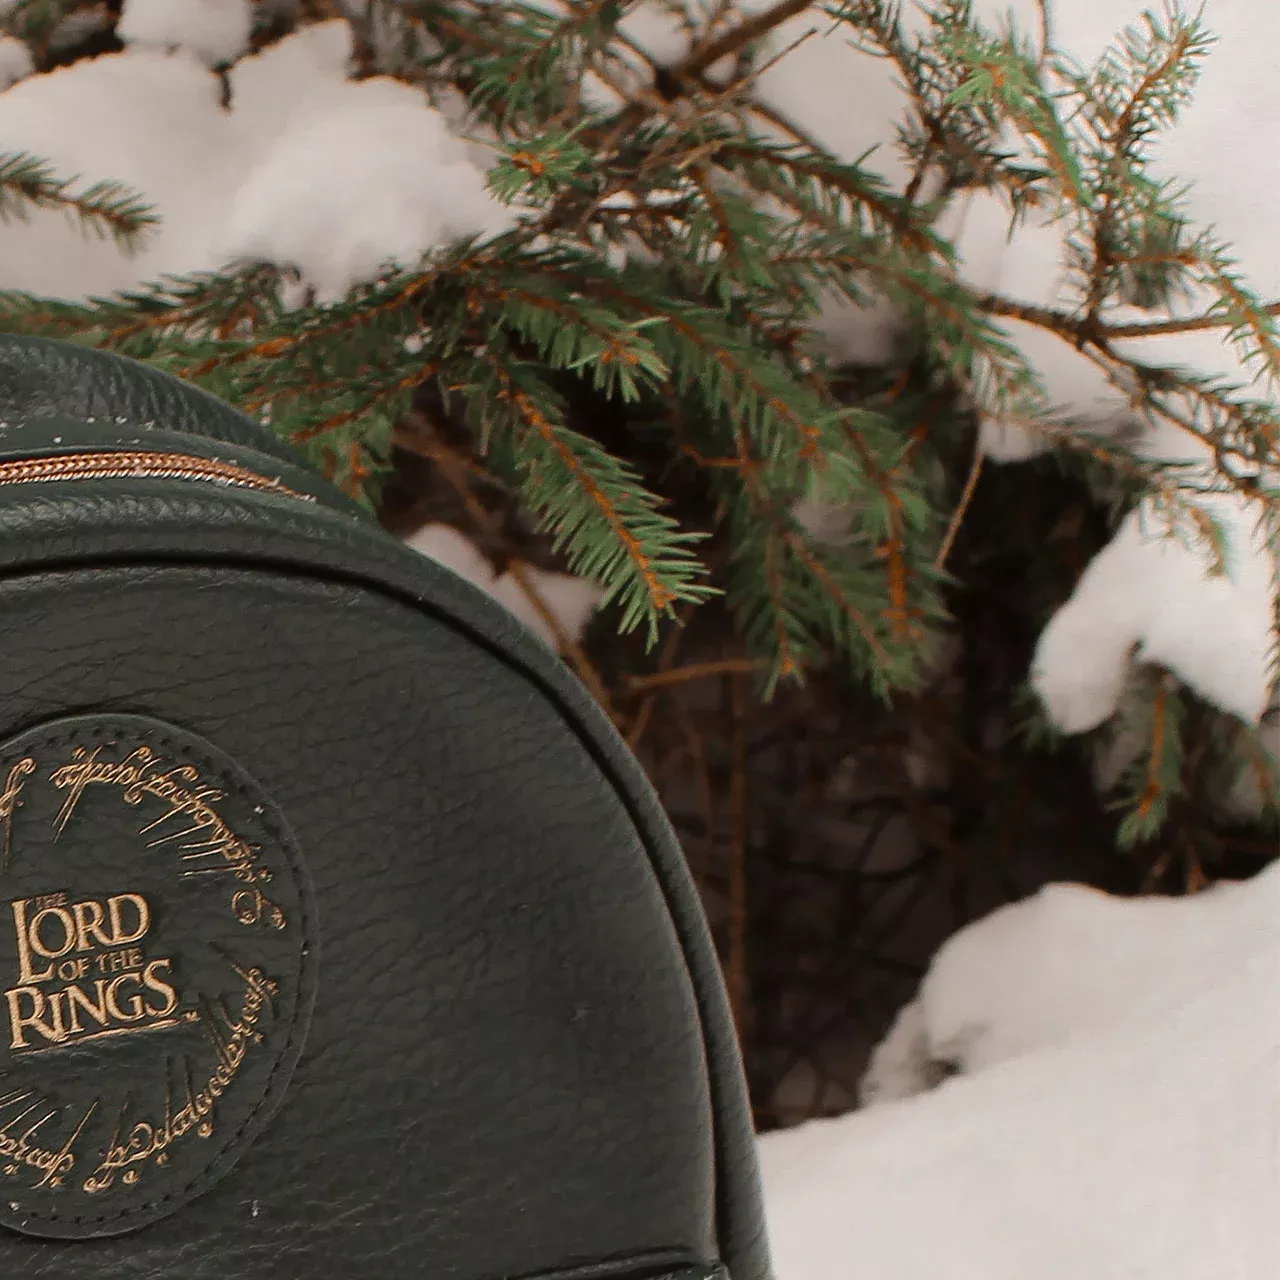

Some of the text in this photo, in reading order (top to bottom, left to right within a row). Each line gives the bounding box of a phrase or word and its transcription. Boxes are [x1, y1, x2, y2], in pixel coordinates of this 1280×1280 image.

[11, 892, 151, 985] LORD
[57, 947, 145, 982] OF THE
[4, 958, 178, 1049] RINGS
